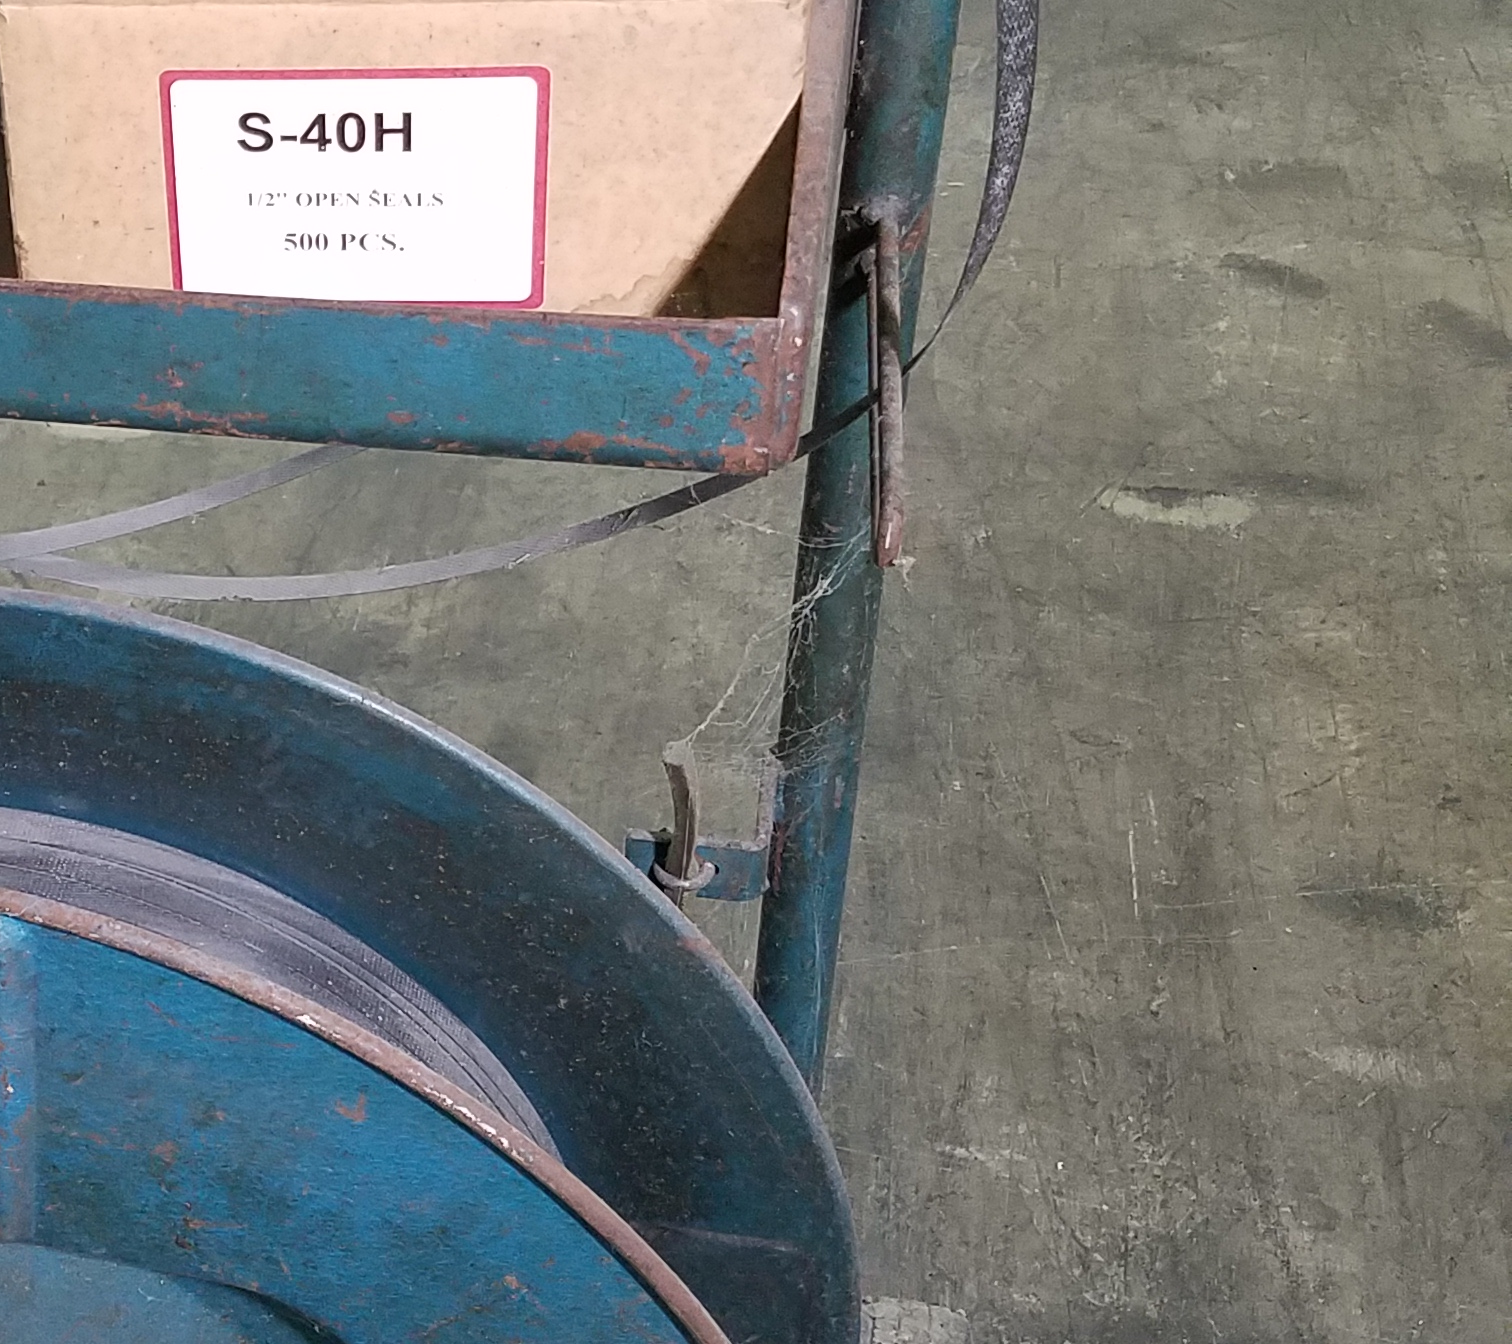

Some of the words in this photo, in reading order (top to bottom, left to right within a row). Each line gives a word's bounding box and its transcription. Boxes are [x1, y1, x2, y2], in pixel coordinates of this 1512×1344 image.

[237, 112, 412, 153] S-40H
[295, 192, 360, 208] OPEN
[368, 190, 444, 207] SEALS
[284, 232, 329, 252] 500
[340, 232, 405, 252] PCS.
